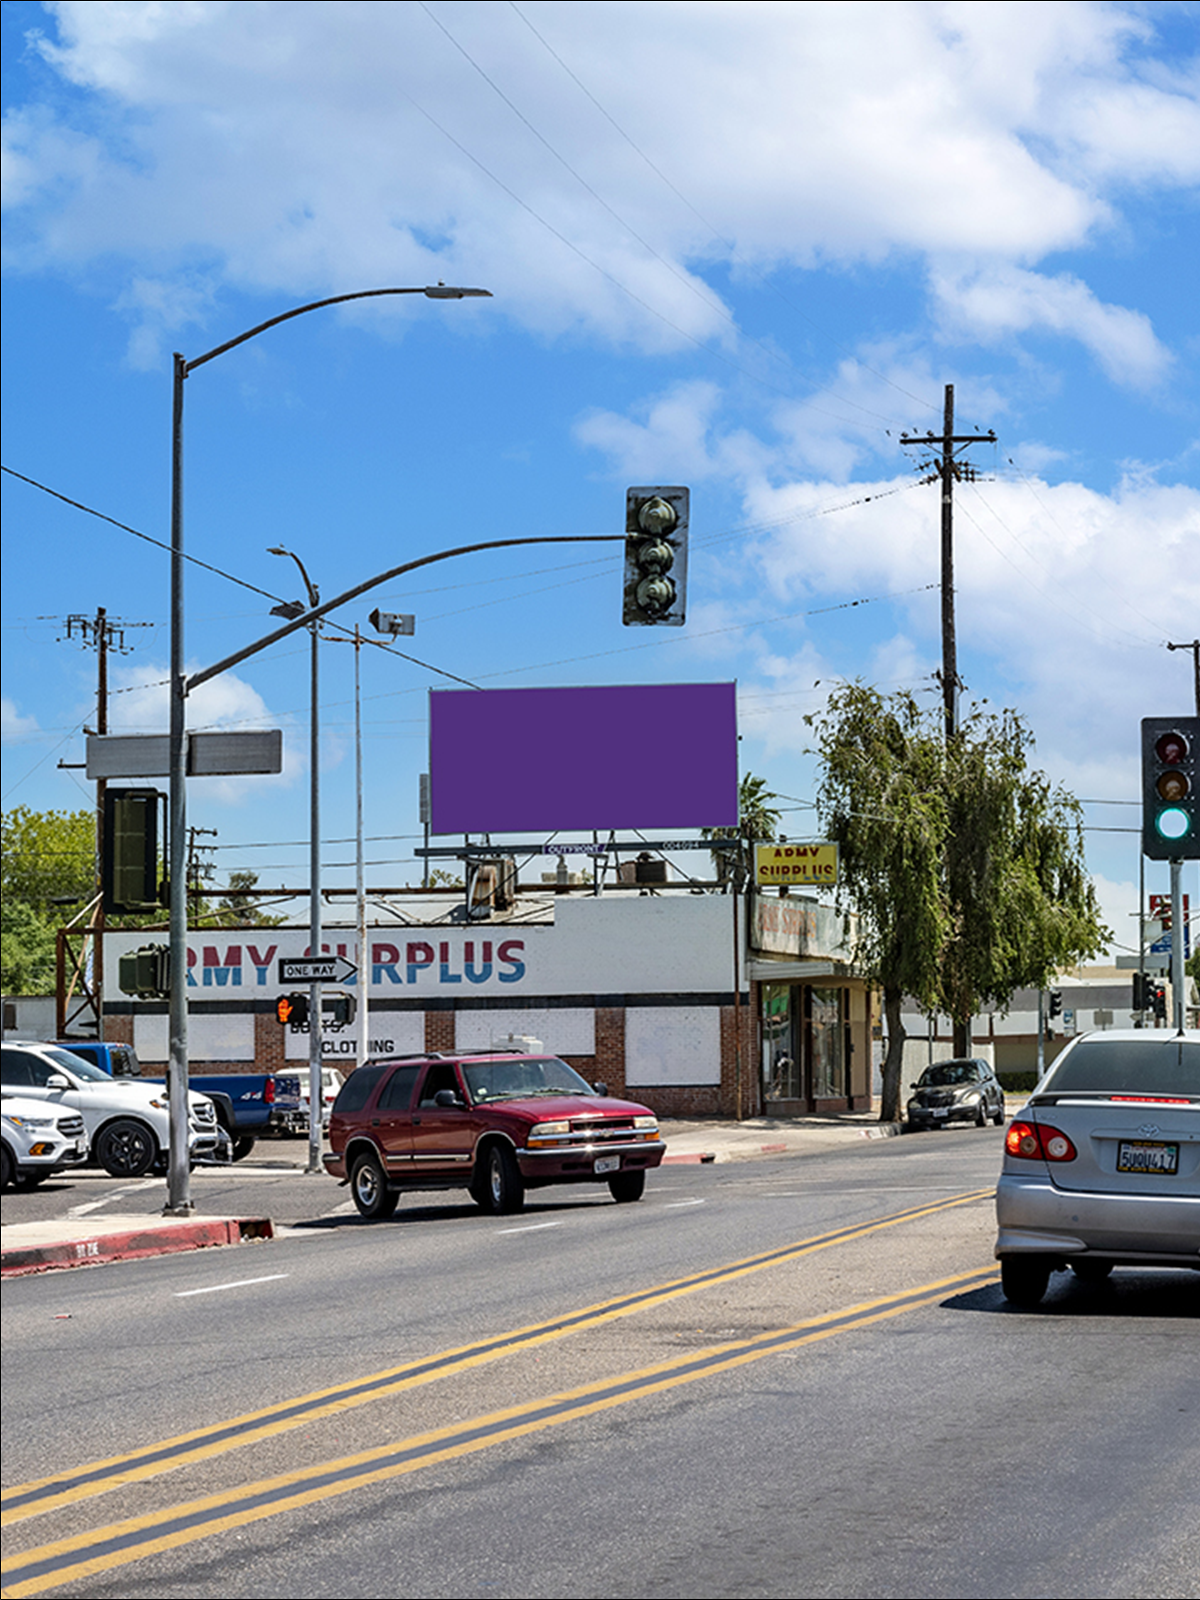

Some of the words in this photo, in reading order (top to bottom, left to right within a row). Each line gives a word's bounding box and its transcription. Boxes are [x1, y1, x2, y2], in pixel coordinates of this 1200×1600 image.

[187, 944, 278, 987] MY
[286, 966, 310, 977] ONE
[312, 964, 335, 975] WAY
[321, 1040, 394, 1054] CLOTING
